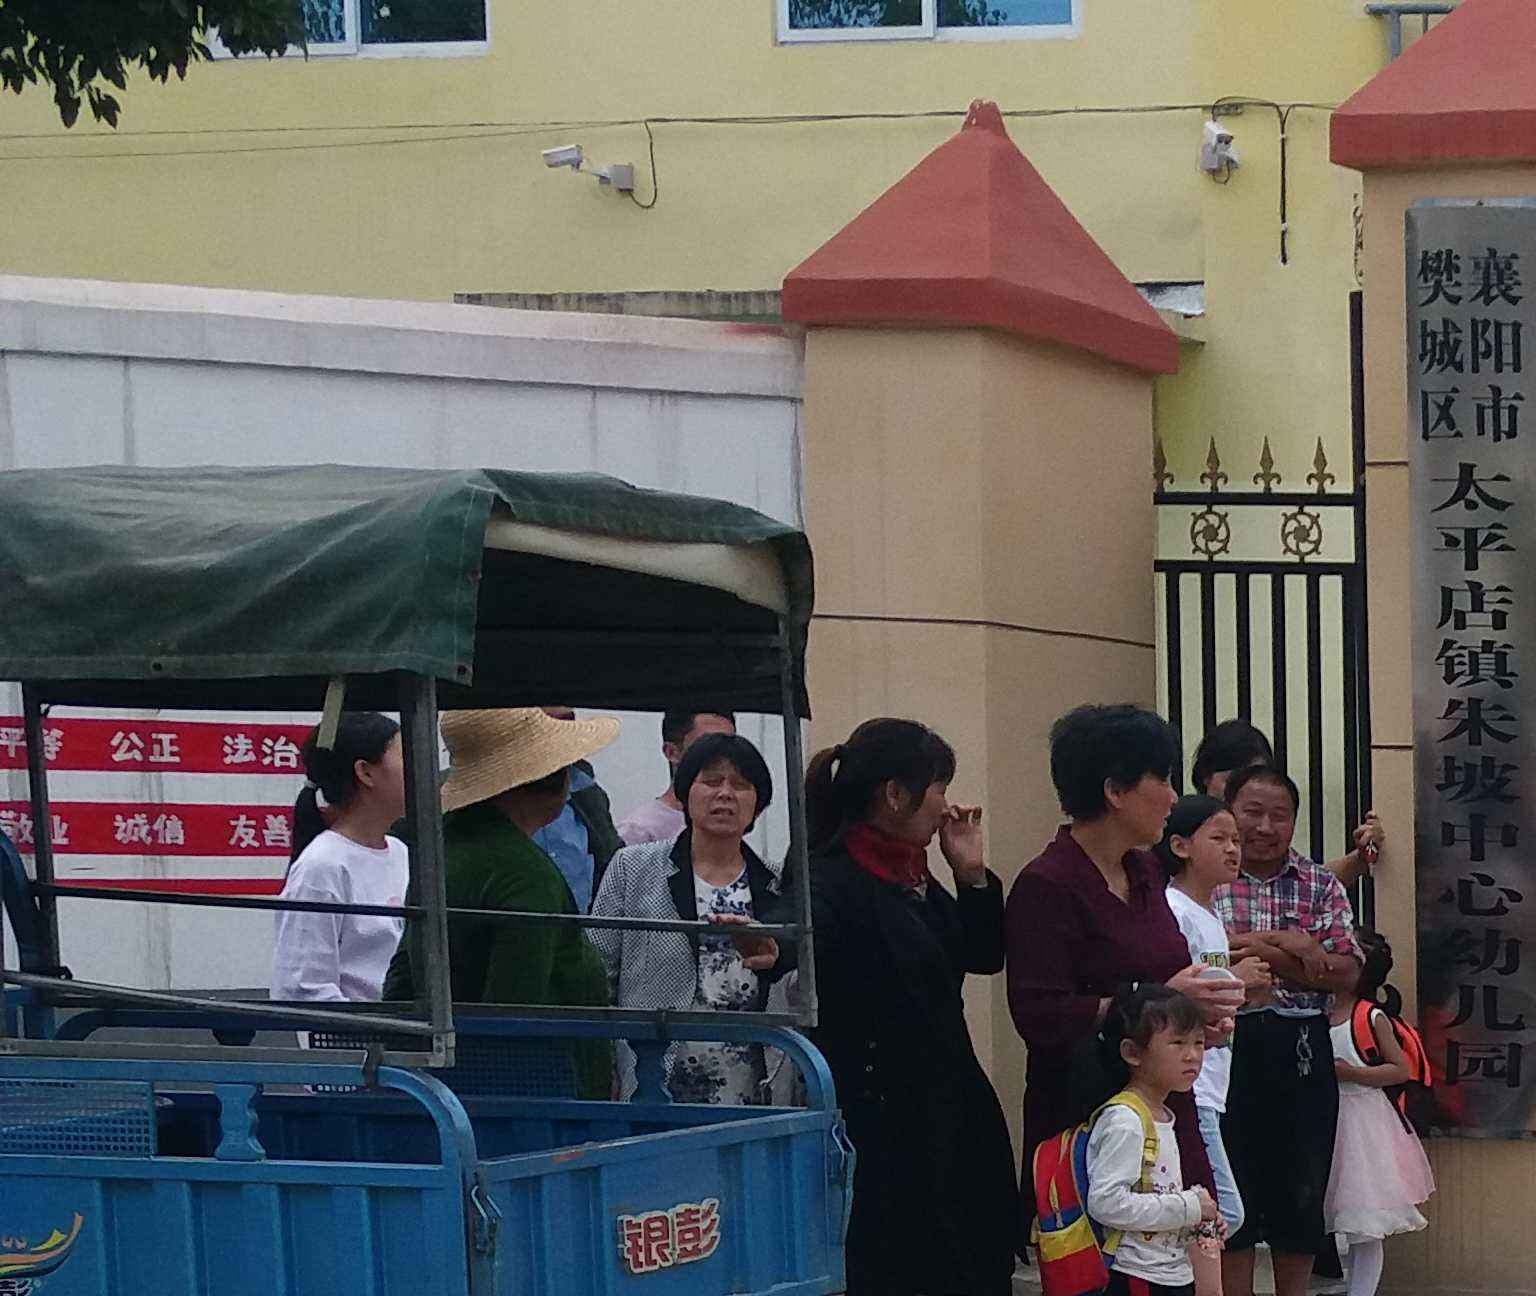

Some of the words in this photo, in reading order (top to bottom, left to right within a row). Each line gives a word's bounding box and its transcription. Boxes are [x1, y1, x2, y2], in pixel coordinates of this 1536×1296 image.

[1416, 247, 1464, 442] 樊城区
[1467, 247, 1525, 443] 襄阳市
[110, 730, 181, 763] 公正
[222, 733, 300, 769] 法治
[1431, 461, 1526, 1089] 太平店镇朱坡中心幼儿园
[113, 813, 186, 846] 诚信
[229, 814, 292, 849] 友善
[618, 1198, 720, 1273] 银彭
